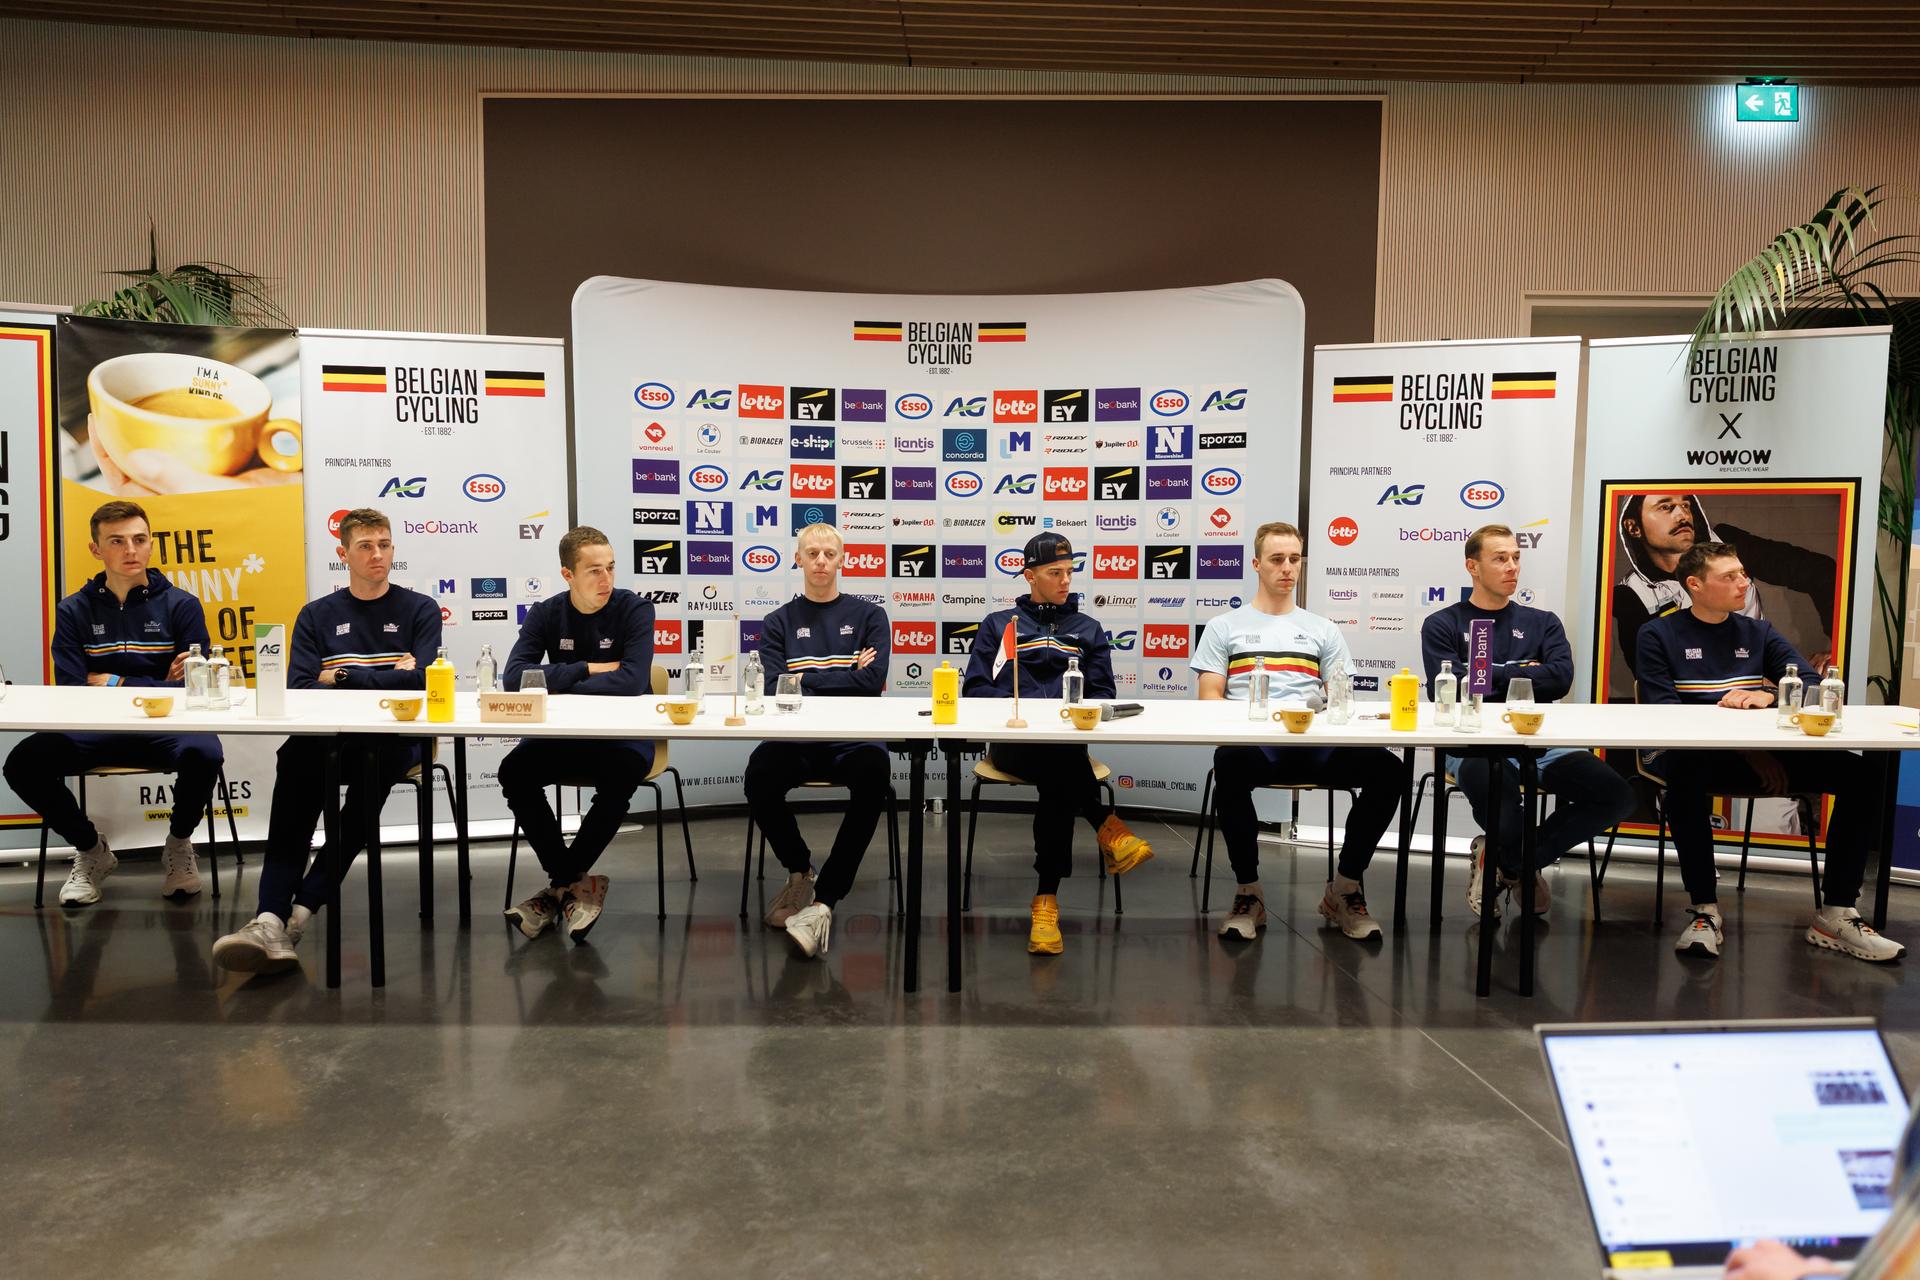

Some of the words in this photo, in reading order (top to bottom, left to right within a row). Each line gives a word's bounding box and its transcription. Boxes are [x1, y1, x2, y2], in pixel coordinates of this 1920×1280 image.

[908, 321, 973, 343] BELGIAN
[908, 343, 972, 365] CYCLING
[1690, 346, 1778, 375] BELGIAN
[197, 366, 212, 380] I'M
[213, 371, 220, 380] A
[395, 366, 478, 396] BELGIAN
[1401, 373, 1484, 401] BELGIAN
[1689, 375, 1776, 403] CYCLING
[641, 389, 669, 402] Esso
[686, 389, 732, 410] AG
[1156, 397, 1184, 408] Esso
[1200, 389, 1248, 412] AG
[396, 396, 479, 424] CYCLING
[797, 403, 823, 419] EY
[901, 400, 928, 411] Esso
[943, 397, 987, 417] AG
[1051, 405, 1077, 421] EY
[1400, 402, 1483, 430] CYCLING
[437, 427, 452, 436] 1882
[1717, 412, 1743, 439] X
[750, 437, 783, 446] BIORACER
[894, 437, 934, 449] liantis
[1154, 427, 1184, 453] N
[1439, 434, 1454, 442] 1882
[325, 458, 358, 467] PRINCIPAL
[359, 459, 392, 468] PARTNERS
[1686, 449, 1772, 466] WOWOW
[695, 472, 723, 484] Esso
[1330, 467, 1360, 476] PRINCIPAL
[1361, 466, 1392, 475] PARTNERS
[378, 477, 427, 498] AG
[469, 481, 499, 494] Esso
[739, 470, 784, 491] AG
[951, 477, 977, 488] Esso
[993, 474, 1037, 494] AG
[1208, 474, 1236, 486] Esso
[849, 482, 875, 498] EY
[1101, 483, 1127, 499] EY
[1376, 484, 1426, 505] AG
[1467, 488, 1498, 501] Esso
[695, 503, 724, 528] N
[998, 516, 1036, 525] CBTW
[1056, 519, 1087, 527] Bekaert
[1096, 515, 1137, 527] liantis
[519, 524, 544, 540] EY
[1516, 532, 1543, 548] EY
[152, 529, 216, 565] THE
[642, 556, 668, 573] EY
[748, 552, 775, 564] Esso
[899, 560, 924, 576] EY
[1152, 562, 1178, 578] EY
[1326, 567, 1342, 576] MAIN
[1343, 568, 1348, 576] &
[1348, 568, 1368, 577] MEDIA
[1368, 568, 1400, 577] PARTNERS
[166, 554, 265, 603] NNY
[901, 593, 935, 602] YAMAHA
[942, 595, 986, 606] Campine
[1106, 594, 1137, 605] Limar
[218, 606, 255, 641] OF
[654, 630, 680, 646] tto
[950, 638, 974, 653] EY
[259, 644, 281, 654] AG
[710, 665, 725, 674] EY
[1366, 660, 1396, 669] PARTNERS
[489, 702, 533, 712] WOWOW
